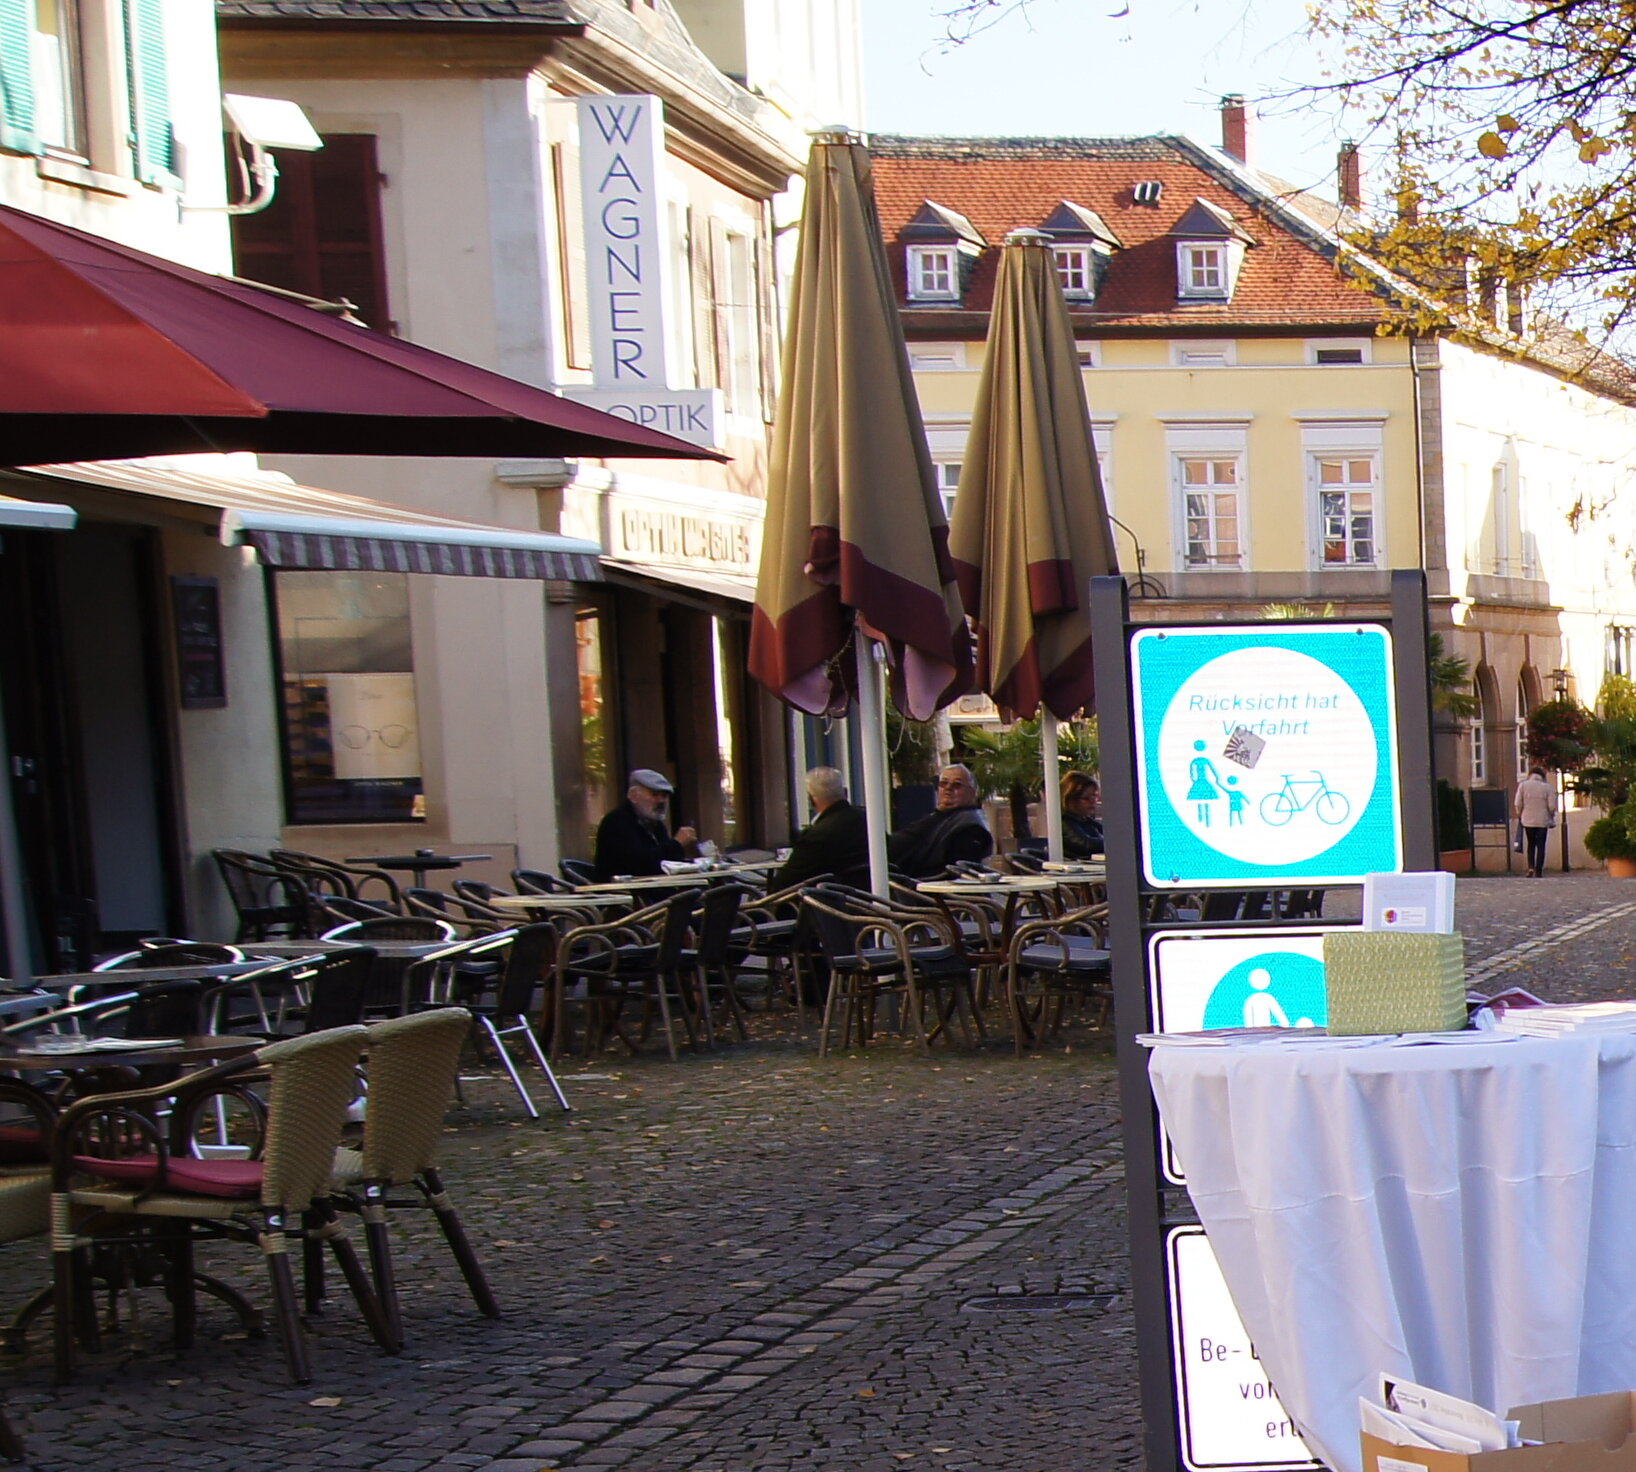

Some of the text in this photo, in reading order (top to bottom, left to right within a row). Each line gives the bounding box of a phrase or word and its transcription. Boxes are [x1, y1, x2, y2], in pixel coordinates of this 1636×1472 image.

[589, 104, 647, 379] WAGNER
[1189, 693, 1340, 711] Rücksicht hat
